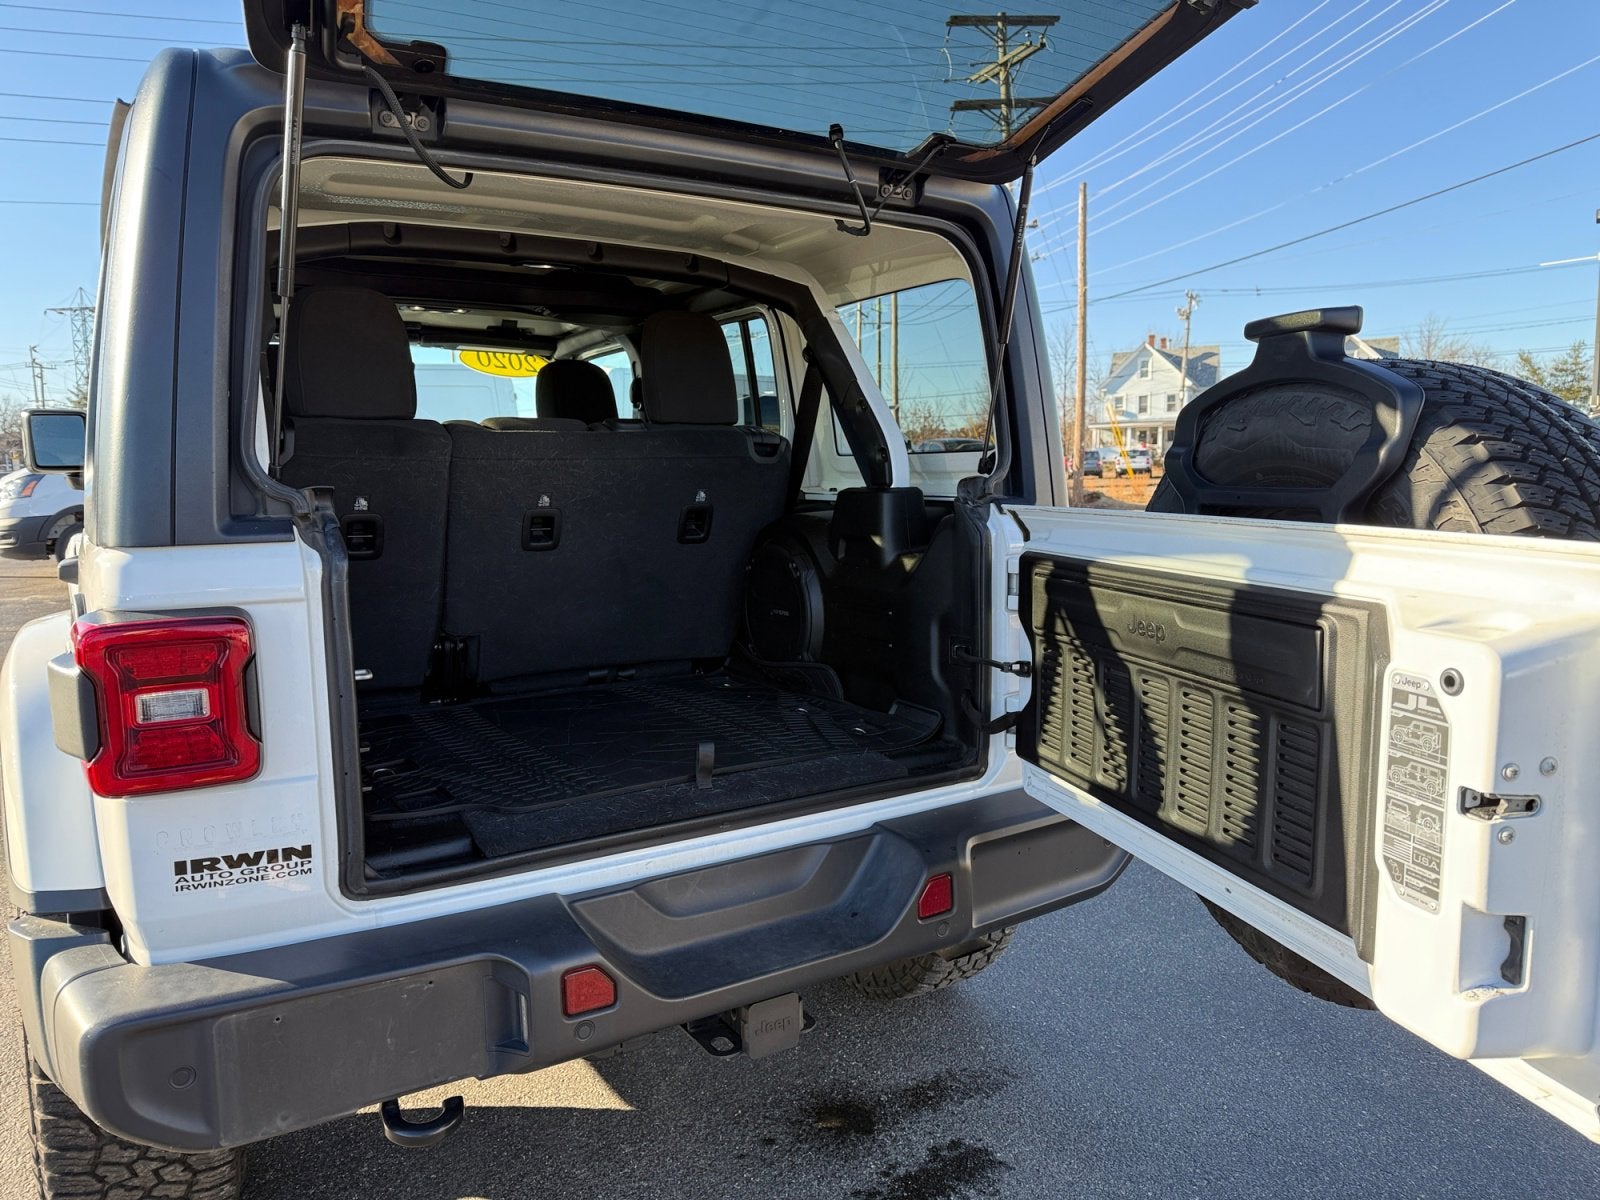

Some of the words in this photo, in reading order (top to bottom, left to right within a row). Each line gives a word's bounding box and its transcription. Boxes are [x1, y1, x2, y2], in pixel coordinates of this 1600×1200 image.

[1127, 614, 1166, 645] Jeep
[1401, 677, 1421, 690] Jeep
[1392, 693, 1442, 714] JL
[174, 844, 312, 876] IRWIN
[1413, 853, 1440, 872] USA
[175, 870, 233, 885] AUTO
[240, 860, 312, 876] GROUP
[175, 867, 312, 892] IRWINZONE.COM
[754, 1015, 792, 1037] Jeep
